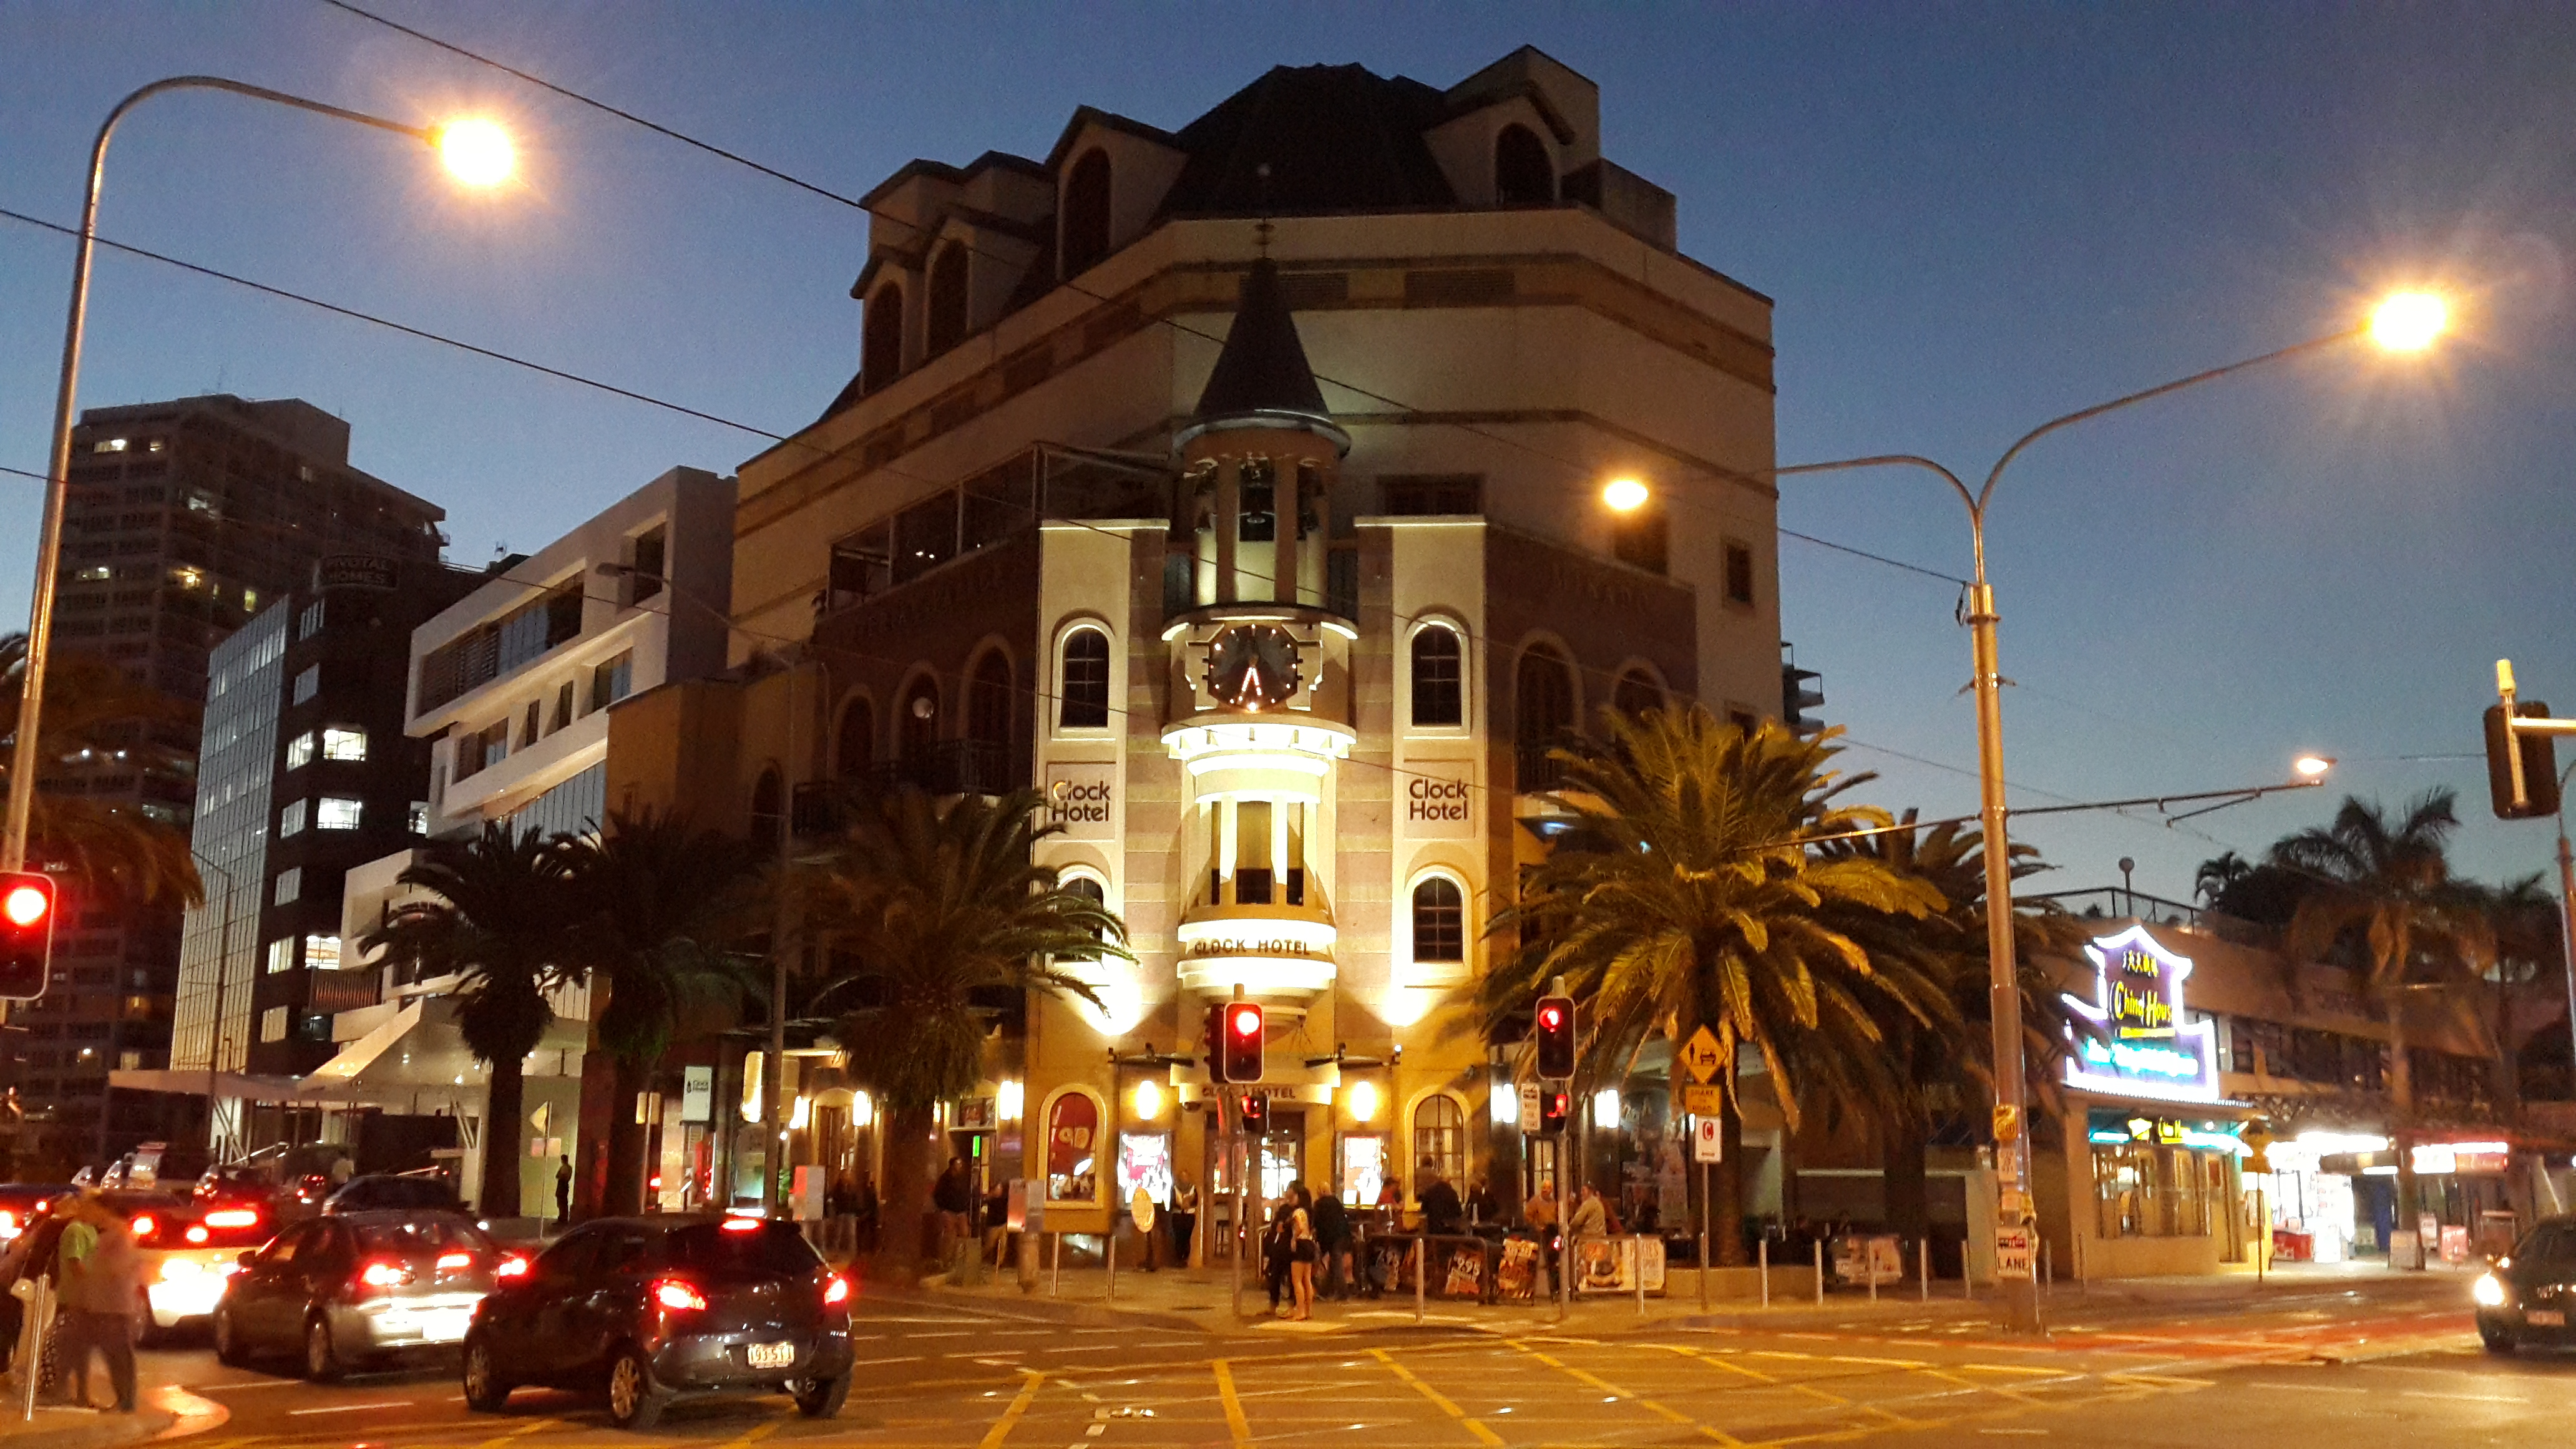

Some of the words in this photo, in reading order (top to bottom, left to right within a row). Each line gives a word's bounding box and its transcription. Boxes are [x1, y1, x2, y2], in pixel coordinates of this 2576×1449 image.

[1051, 780, 1111, 801] Clock
[1409, 778, 1468, 799] Clock
[1051, 801, 1110, 822] Hotel
[1409, 799, 1468, 821] Hotel
[1194, 939, 1247, 955] CLOCK
[1257, 939, 1310, 956] HOTEL
[1997, 1256, 2027, 1271] LANE
